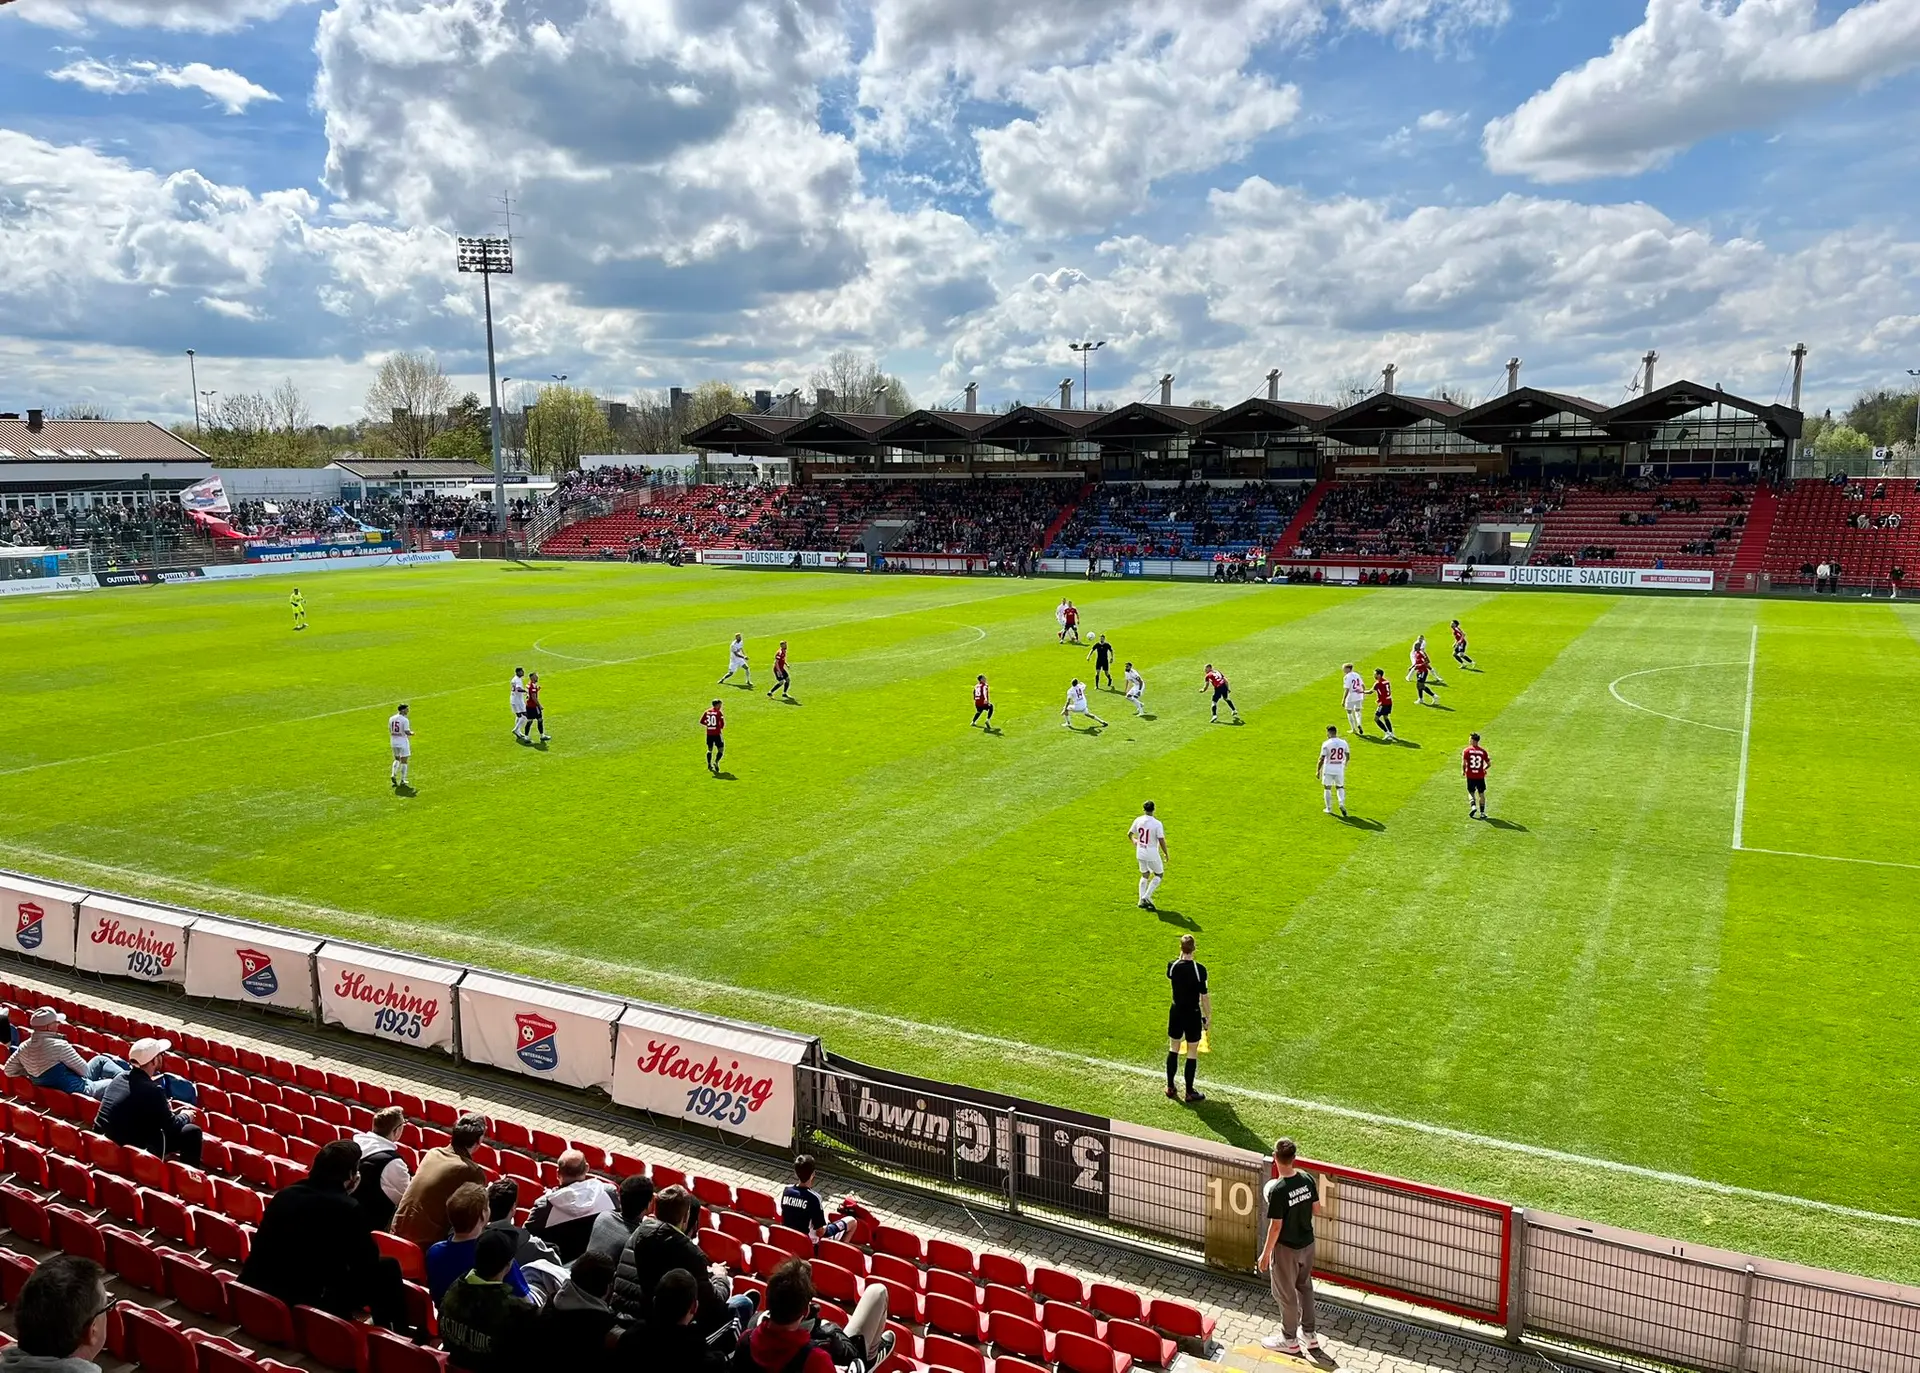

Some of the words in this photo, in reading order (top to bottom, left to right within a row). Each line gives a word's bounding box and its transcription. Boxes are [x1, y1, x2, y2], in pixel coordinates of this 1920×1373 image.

[1875, 449, 1884, 458] G
[745, 551, 784, 564] DEUTSCHE
[1509, 567, 1573, 583] DEUTSCHE
[1580, 569, 1636, 585] SAATGUT
[391, 721, 400, 733] 15
[706, 715, 717, 727] 30
[1330, 747, 1344, 760] 28
[1469, 755, 1482, 769] 33
[1138, 827, 1150, 844] 21
[91, 917, 177, 968] Haching
[127, 950, 163, 976] 1925
[334, 969, 439, 1028] Haching
[374, 1007, 421, 1039] 1925
[637, 1040, 773, 1113] Haching
[685, 1085, 749, 1125] 1925
[858, 1086, 950, 1143] bwin
[859, 1121, 946, 1156] Sportwetten
[1207, 1177, 1254, 1216] 10
